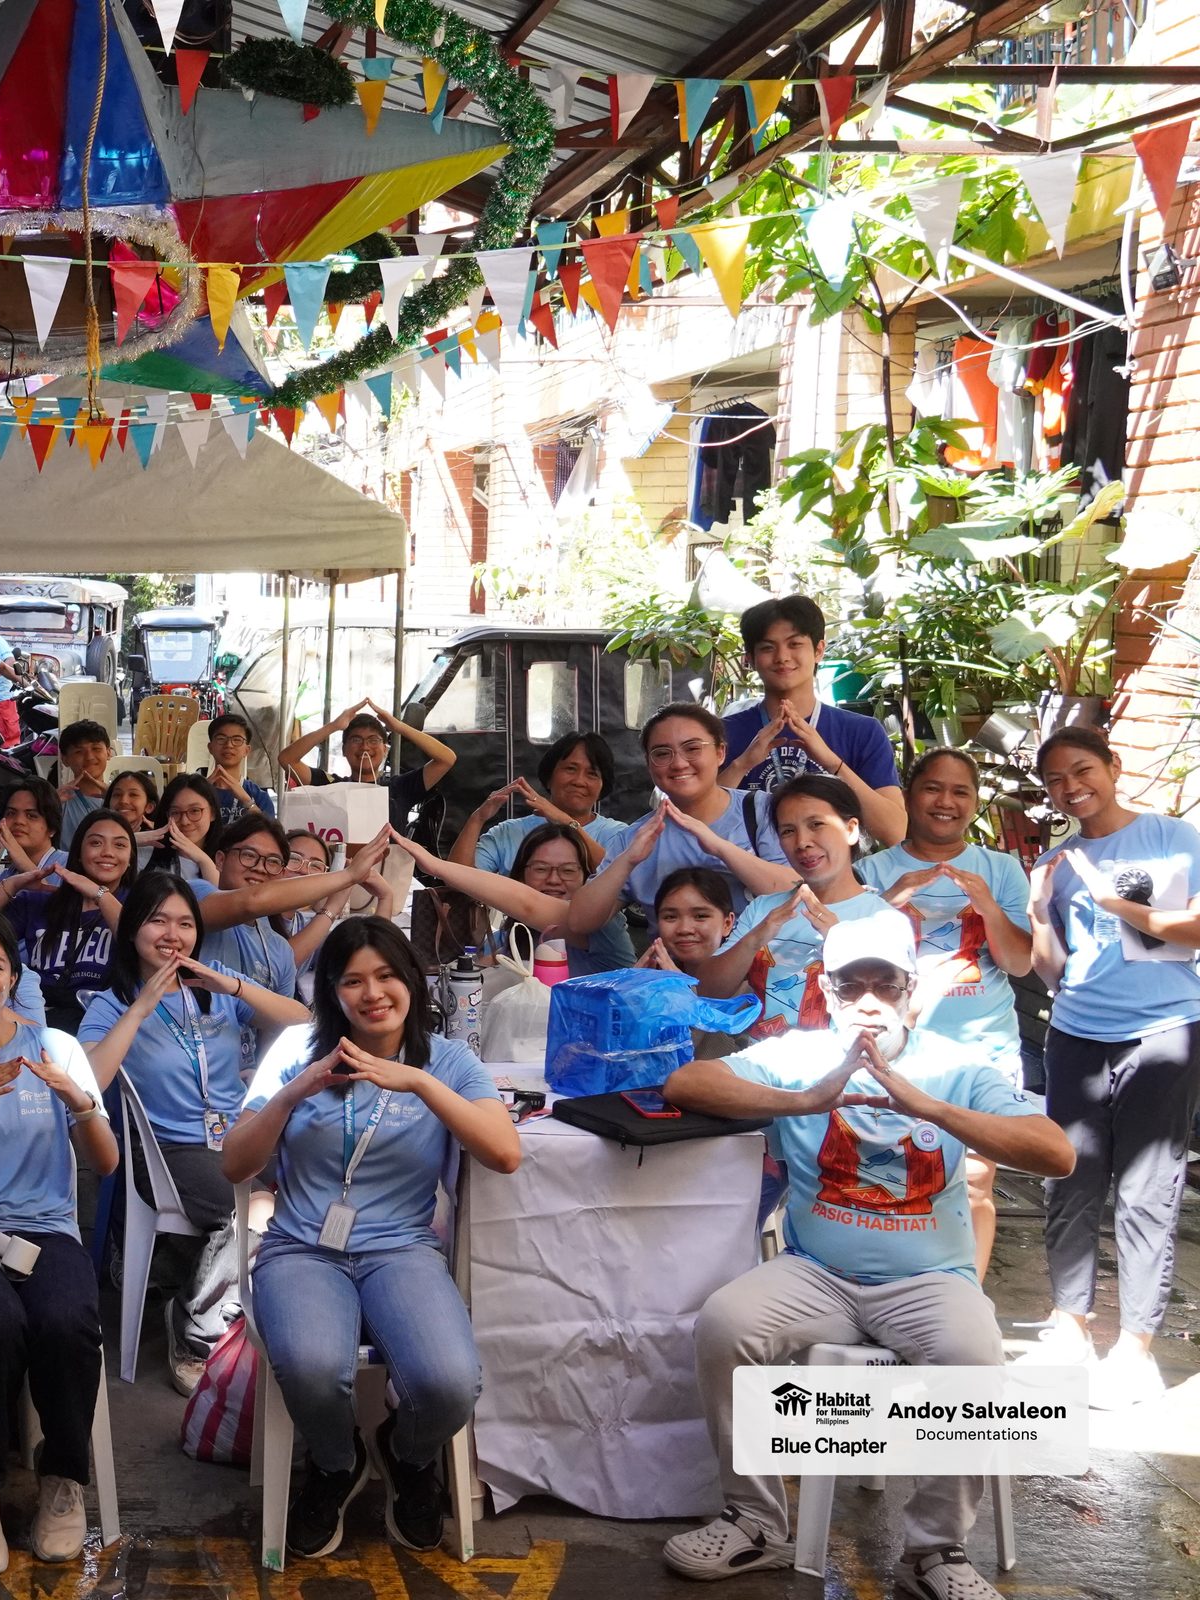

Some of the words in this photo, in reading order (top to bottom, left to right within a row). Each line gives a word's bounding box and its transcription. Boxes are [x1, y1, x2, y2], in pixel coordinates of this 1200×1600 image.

[780, 746, 795, 757] DE
[811, 1202, 854, 1225] PASIG
[856, 1214, 928, 1232] HABITAT
[929, 1216, 938, 1231] 1
